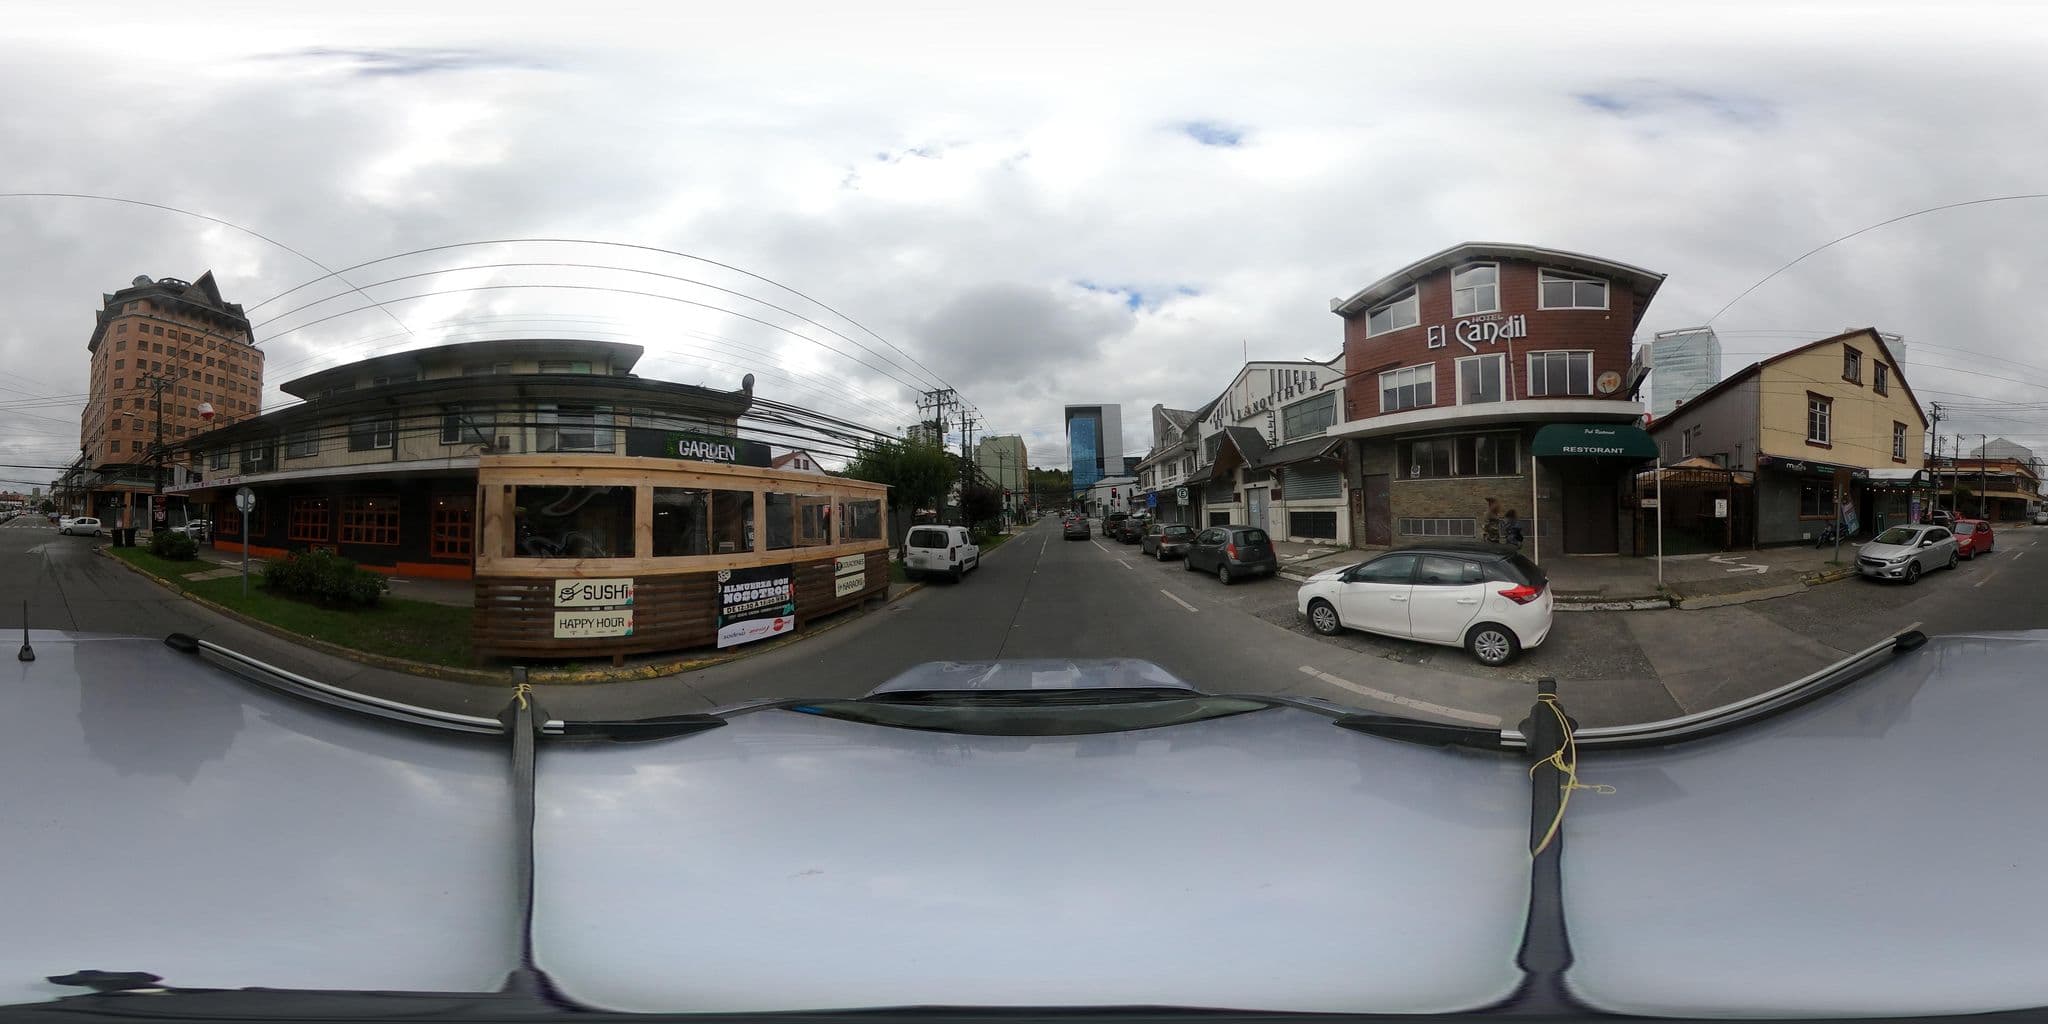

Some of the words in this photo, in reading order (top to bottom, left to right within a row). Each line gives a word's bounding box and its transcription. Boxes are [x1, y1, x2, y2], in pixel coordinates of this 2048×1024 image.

[1472, 314, 1504, 323] HOTEL
[1427, 324, 1447, 349] El
[1455, 314, 1527, 353] Candil
[678, 440, 736, 461] GARDEN
[1562, 446, 1624, 454] RESTORANT
[583, 584, 628, 600] SUSHI
[723, 580, 772, 593] ALMUERZA
[773, 577, 789, 586] CON
[723, 585, 789, 604] NOSOTROS
[559, 618, 595, 629] HAPPY
[596, 617, 625, 628] HOUR
